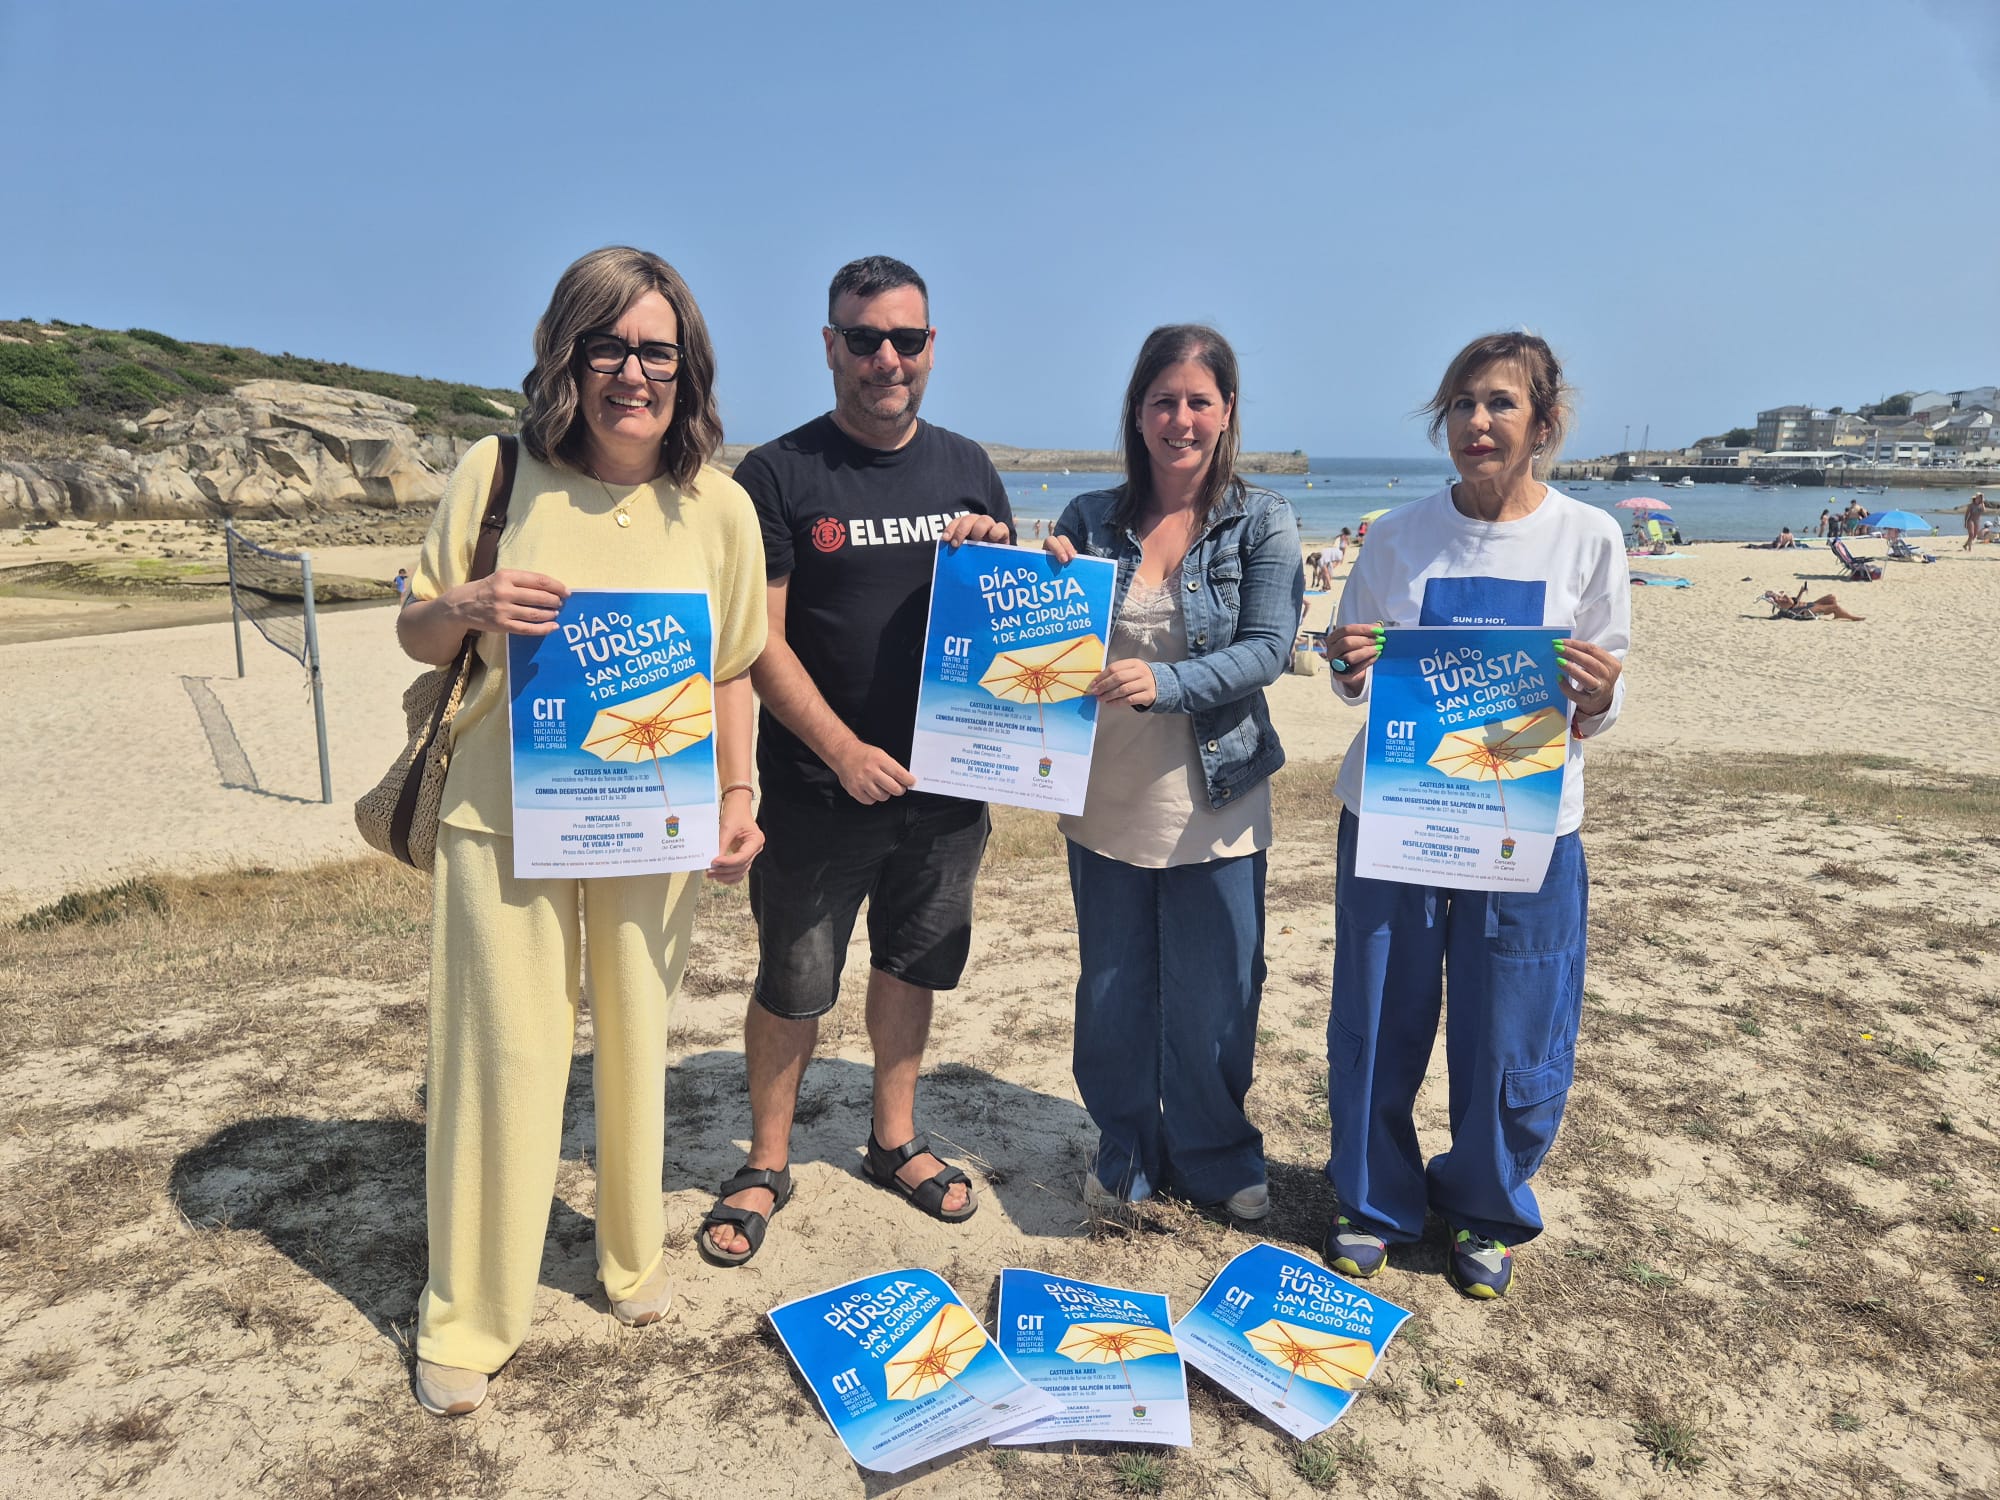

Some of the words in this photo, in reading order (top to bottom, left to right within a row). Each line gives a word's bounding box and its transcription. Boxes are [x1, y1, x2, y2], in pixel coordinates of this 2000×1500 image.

[979, 566, 1018, 592] DÍA
[1018, 568, 1038, 581] DO
[983, 577, 1085, 614] TURISTA
[563, 613, 610, 644] DÍA
[608, 612, 632, 627] DO
[991, 614, 1021, 631] SAN
[1025, 600, 1089, 624] CIPRIÁN
[993, 636, 997, 644] 1
[1001, 633, 1016, 643] DE
[1019, 622, 1064, 640] AGOSTO
[1067, 618, 1092, 629] 2026
[570, 615, 686, 667] TURISTA
[944, 636, 972, 657] CIT
[585, 664, 621, 687] SAN
[624, 639, 692, 674] CIPRIÁN
[1420, 648, 1462, 675] DÍA
[1460, 647, 1483, 661] DO
[1425, 650, 1538, 696] TURISTA
[590, 690, 597, 701] 1
[600, 684, 618, 699] DE
[621, 666, 669, 693] AGOSTO
[671, 656, 696, 674] 2026
[1436, 694, 1469, 713] SAN
[1473, 674, 1544, 703] CIPRIÁN
[533, 699, 566, 720] CIT
[1439, 717, 1445, 725] 1
[1448, 711, 1464, 724] DE
[1468, 699, 1517, 719] AGOSTO
[1520, 690, 1548, 706] 2026
[1387, 720, 1416, 739] CIT
[1043, 1282, 1079, 1294] DÍA
[1281, 1264, 1315, 1282] DÍA
[1317, 1275, 1335, 1288] DO
[837, 1280, 916, 1338] TURISTA
[1048, 1292, 1142, 1311] TURISTA
[1225, 1286, 1255, 1309] CIT
[1276, 1291, 1305, 1307] SAN
[1310, 1300, 1373, 1325] CIPRIÁN
[1279, 1274, 1374, 1312] TURISTA
[824, 1303, 859, 1327] DÍA
[852, 1292, 872, 1303] DO
[859, 1325, 887, 1350] SAN
[884, 1288, 931, 1327] CIPRIÁN
[1017, 1314, 1044, 1330] CIT
[1273, 1303, 1279, 1312] 1
[1280, 1305, 1296, 1316] DE
[1297, 1309, 1343, 1328] AGOSTO
[1346, 1321, 1371, 1336] 2026
[871, 1351, 879, 1359] 1
[878, 1342, 891, 1354] DE
[891, 1311, 922, 1344] AGOSTO
[921, 1295, 941, 1313] 2026
[832, 1368, 862, 1394] CIT
